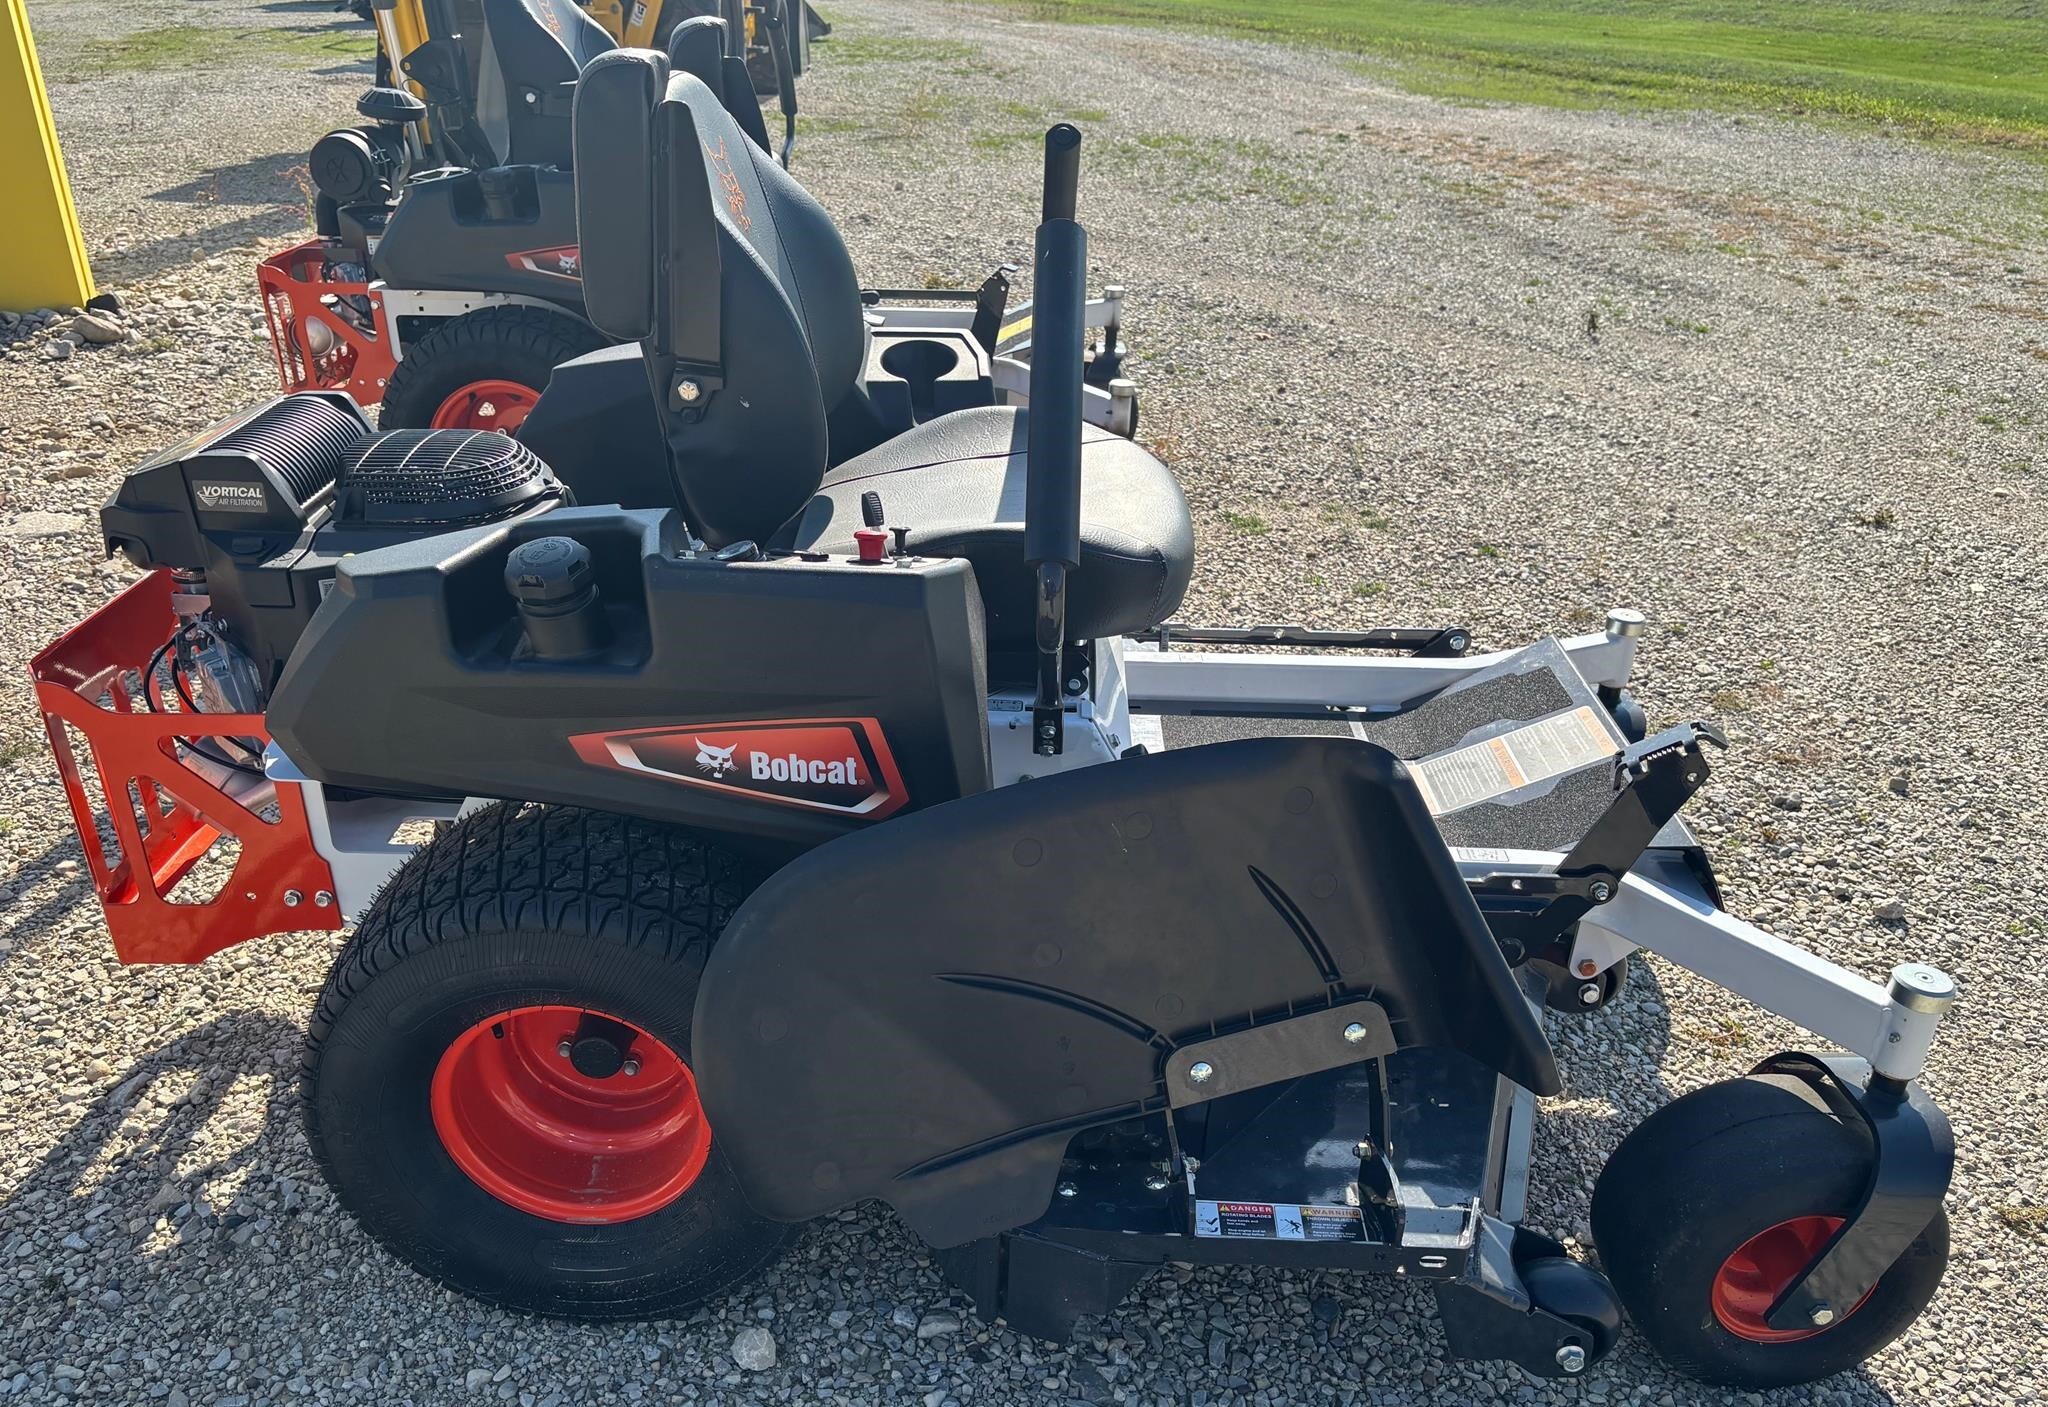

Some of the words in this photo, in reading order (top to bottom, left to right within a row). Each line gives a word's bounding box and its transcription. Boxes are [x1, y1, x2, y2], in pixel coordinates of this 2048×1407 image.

[202, 486, 263, 498] VORTICAL
[230, 498, 263, 507] FILTRATION
[749, 751, 858, 785] Bobcat
[1230, 1205, 1272, 1213] DANGER
[1312, 1208, 1360, 1217] WARNING
